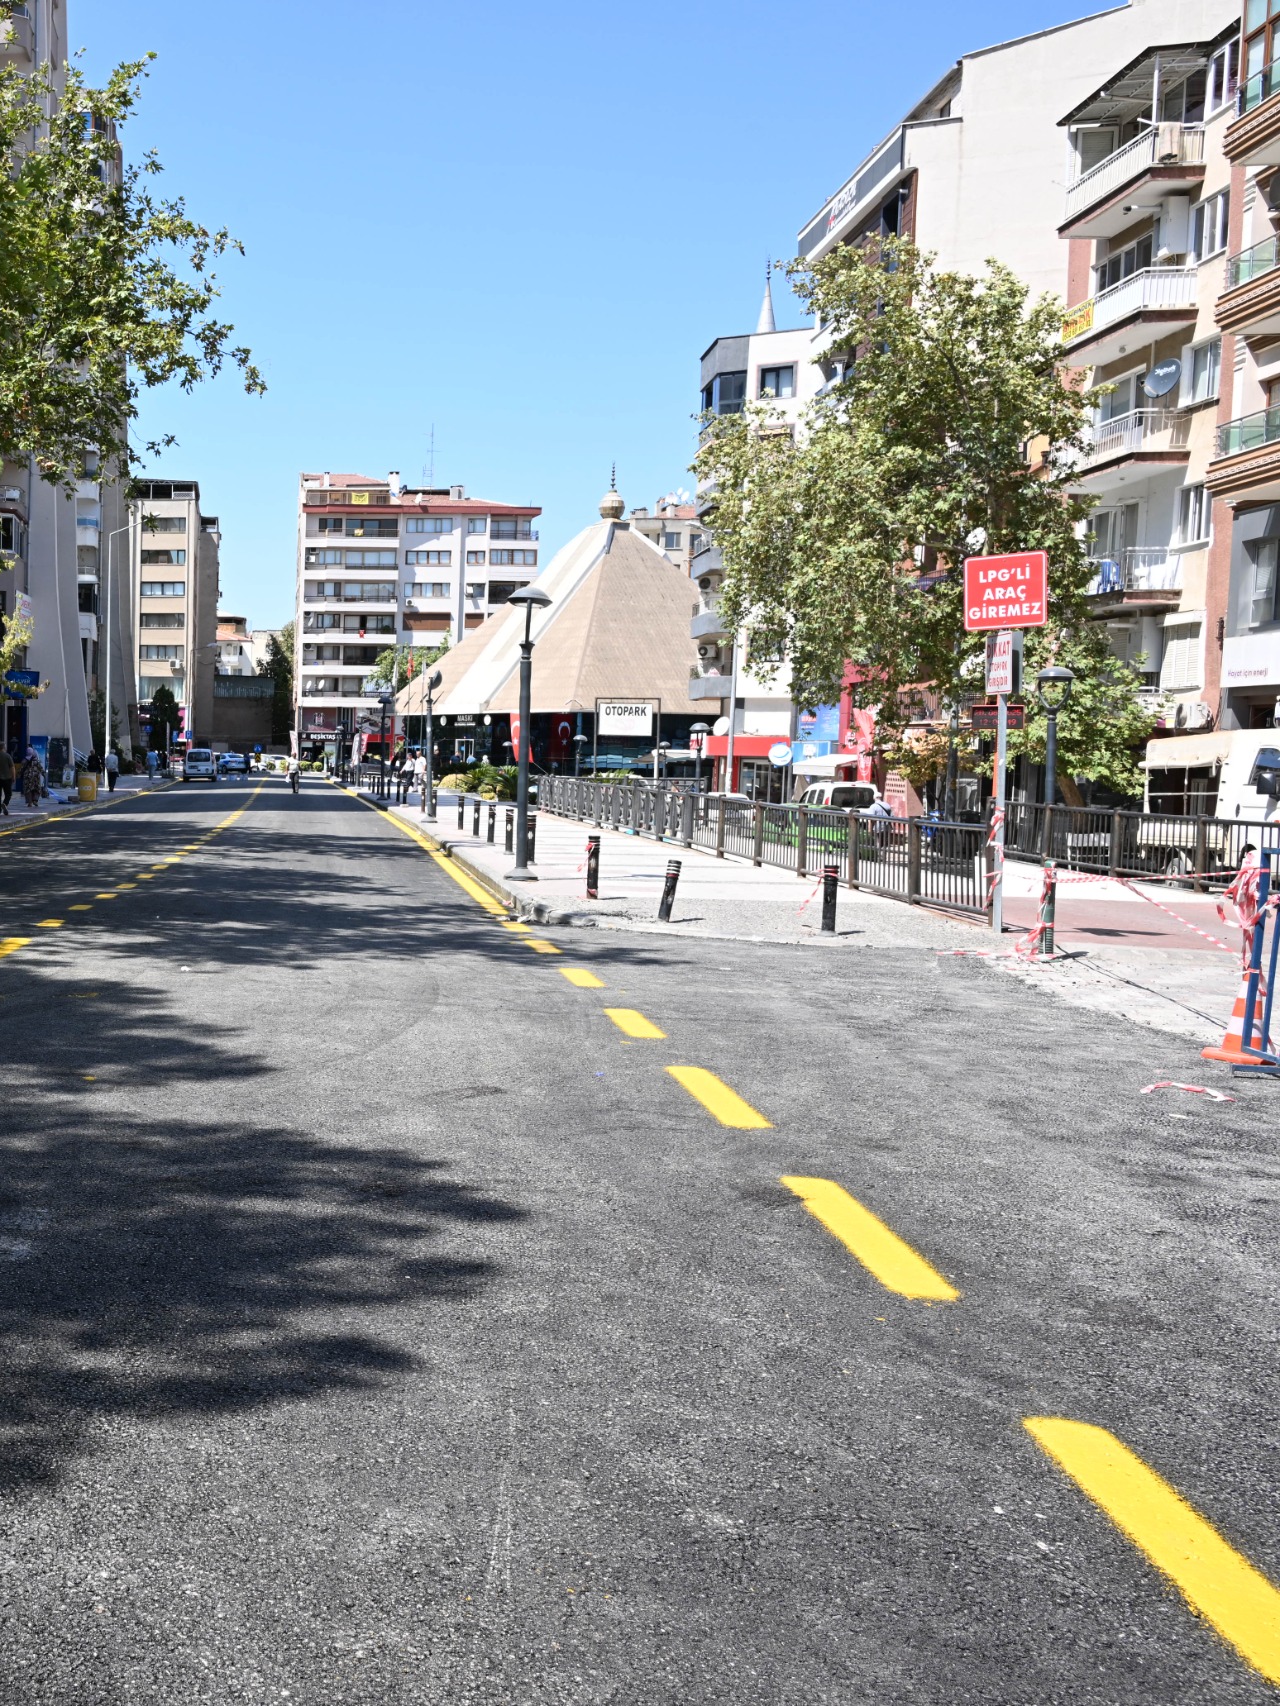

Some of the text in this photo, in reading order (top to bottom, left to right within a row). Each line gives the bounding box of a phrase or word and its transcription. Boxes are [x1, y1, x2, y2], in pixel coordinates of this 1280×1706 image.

[982, 585, 1027, 602] ARAÇ
[968, 601, 1042, 621] GİREMEZ
[986, 639, 1011, 659] DİKKAT
[605, 705, 647, 717] OTOPARK
